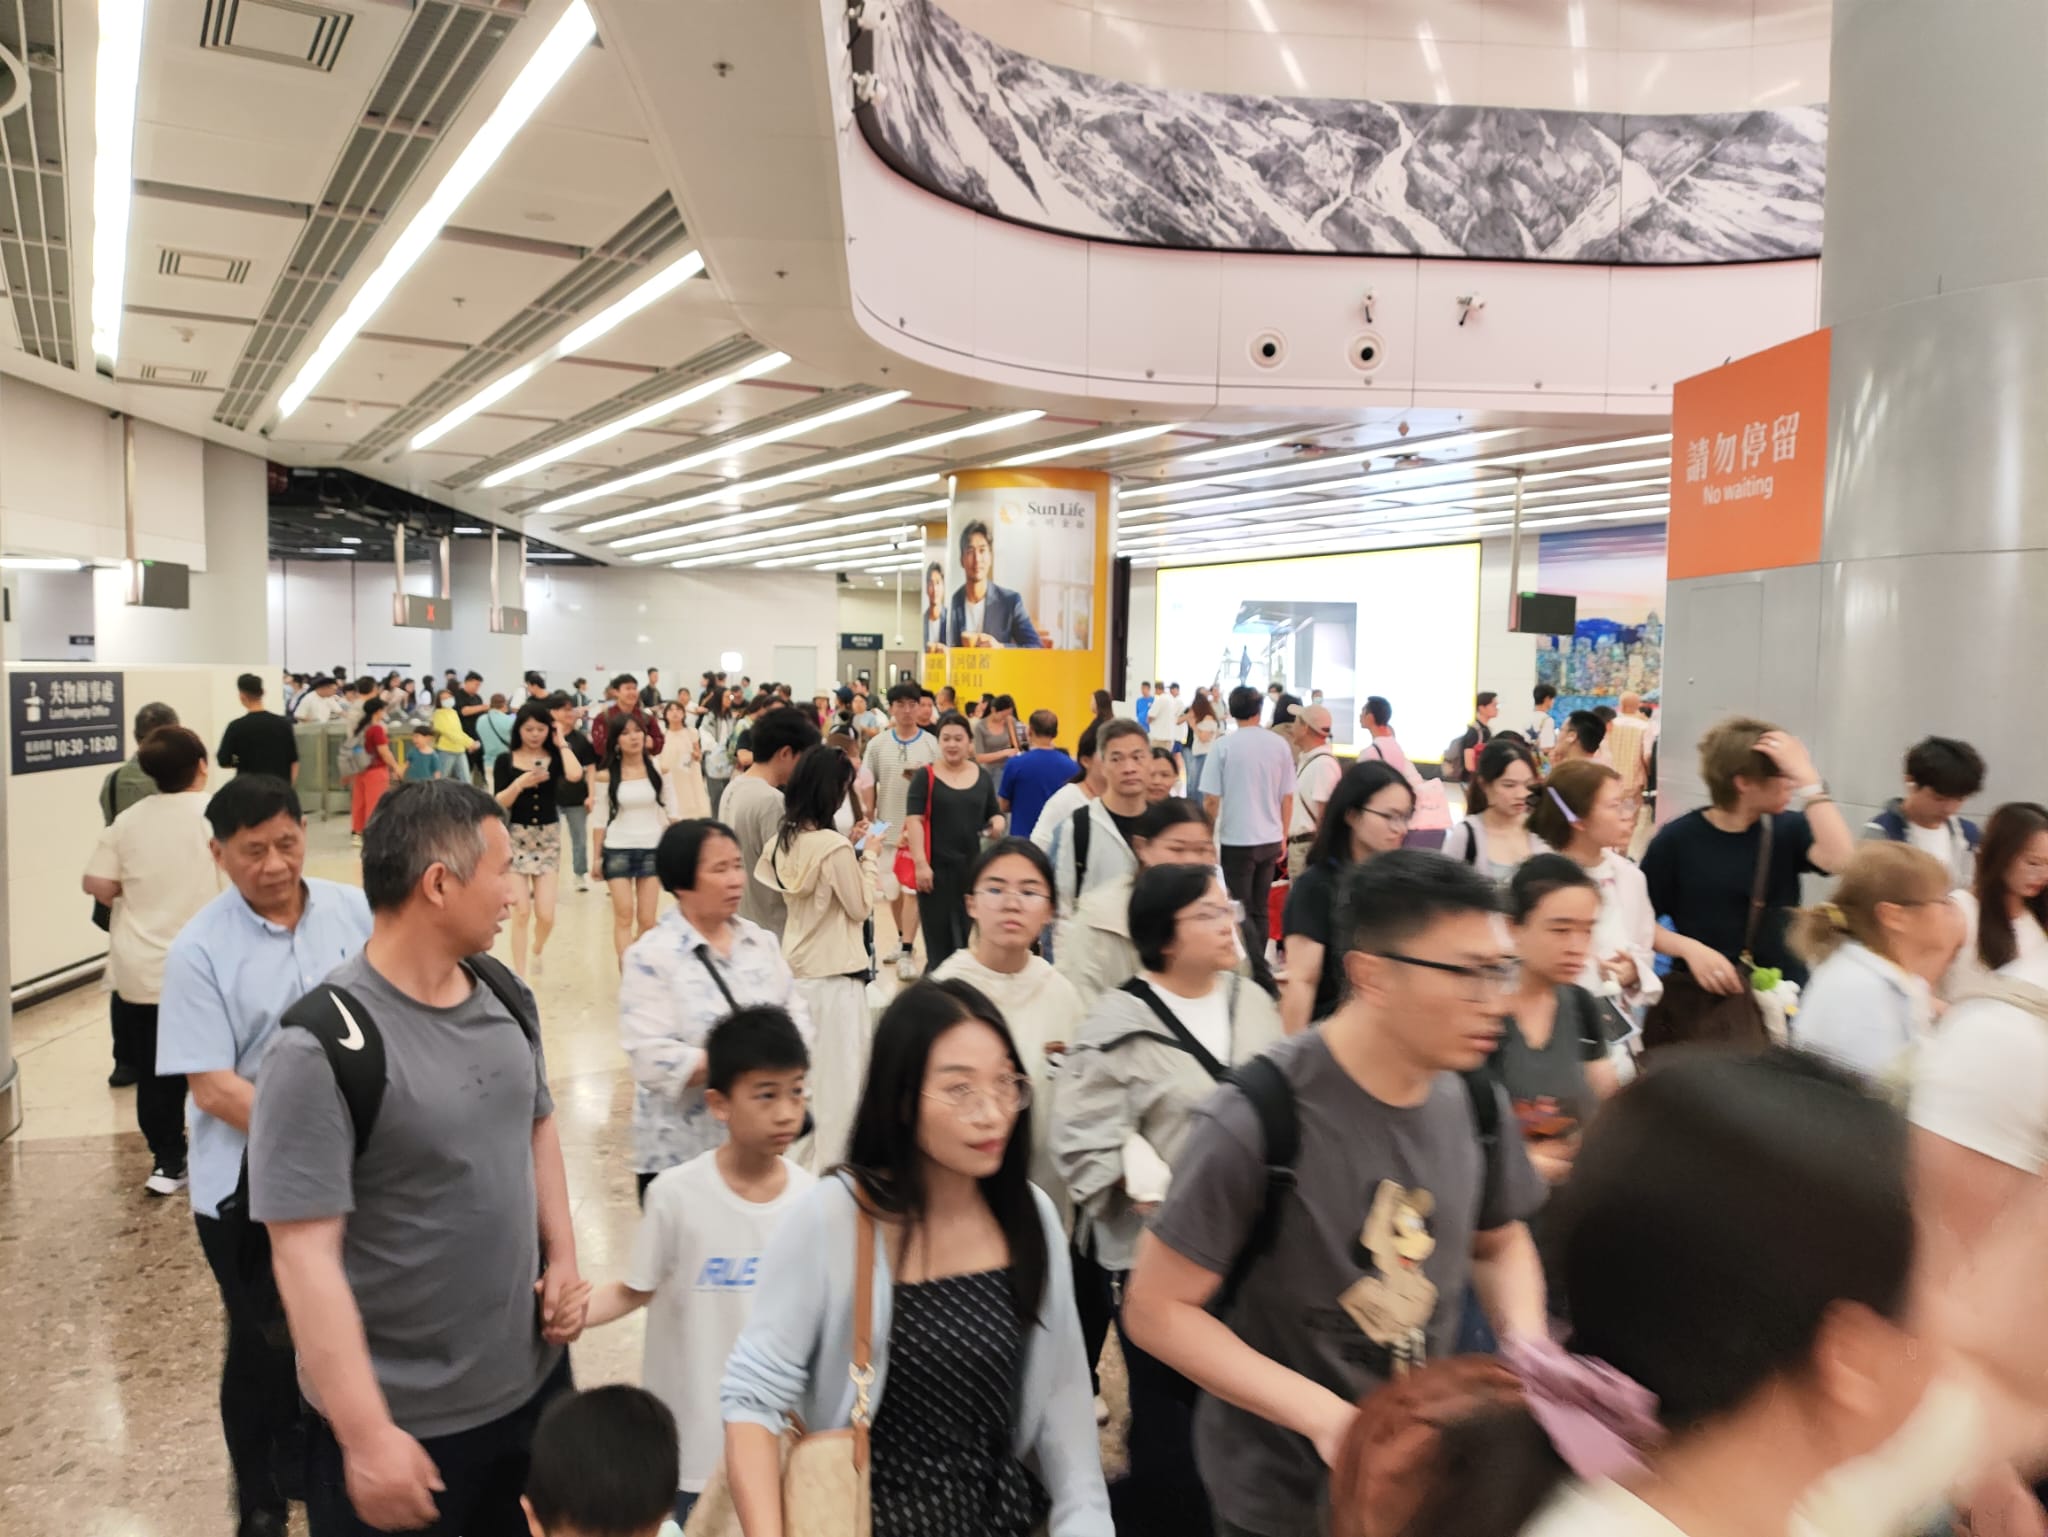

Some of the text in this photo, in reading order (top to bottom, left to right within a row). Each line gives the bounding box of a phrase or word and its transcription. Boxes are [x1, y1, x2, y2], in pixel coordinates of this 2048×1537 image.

[1686, 410, 1800, 483] 請勿停留
[1703, 475, 1774, 505] No waiting
[1027, 501, 1086, 517] Sun Life
[48, 707, 64, 720] Lost
